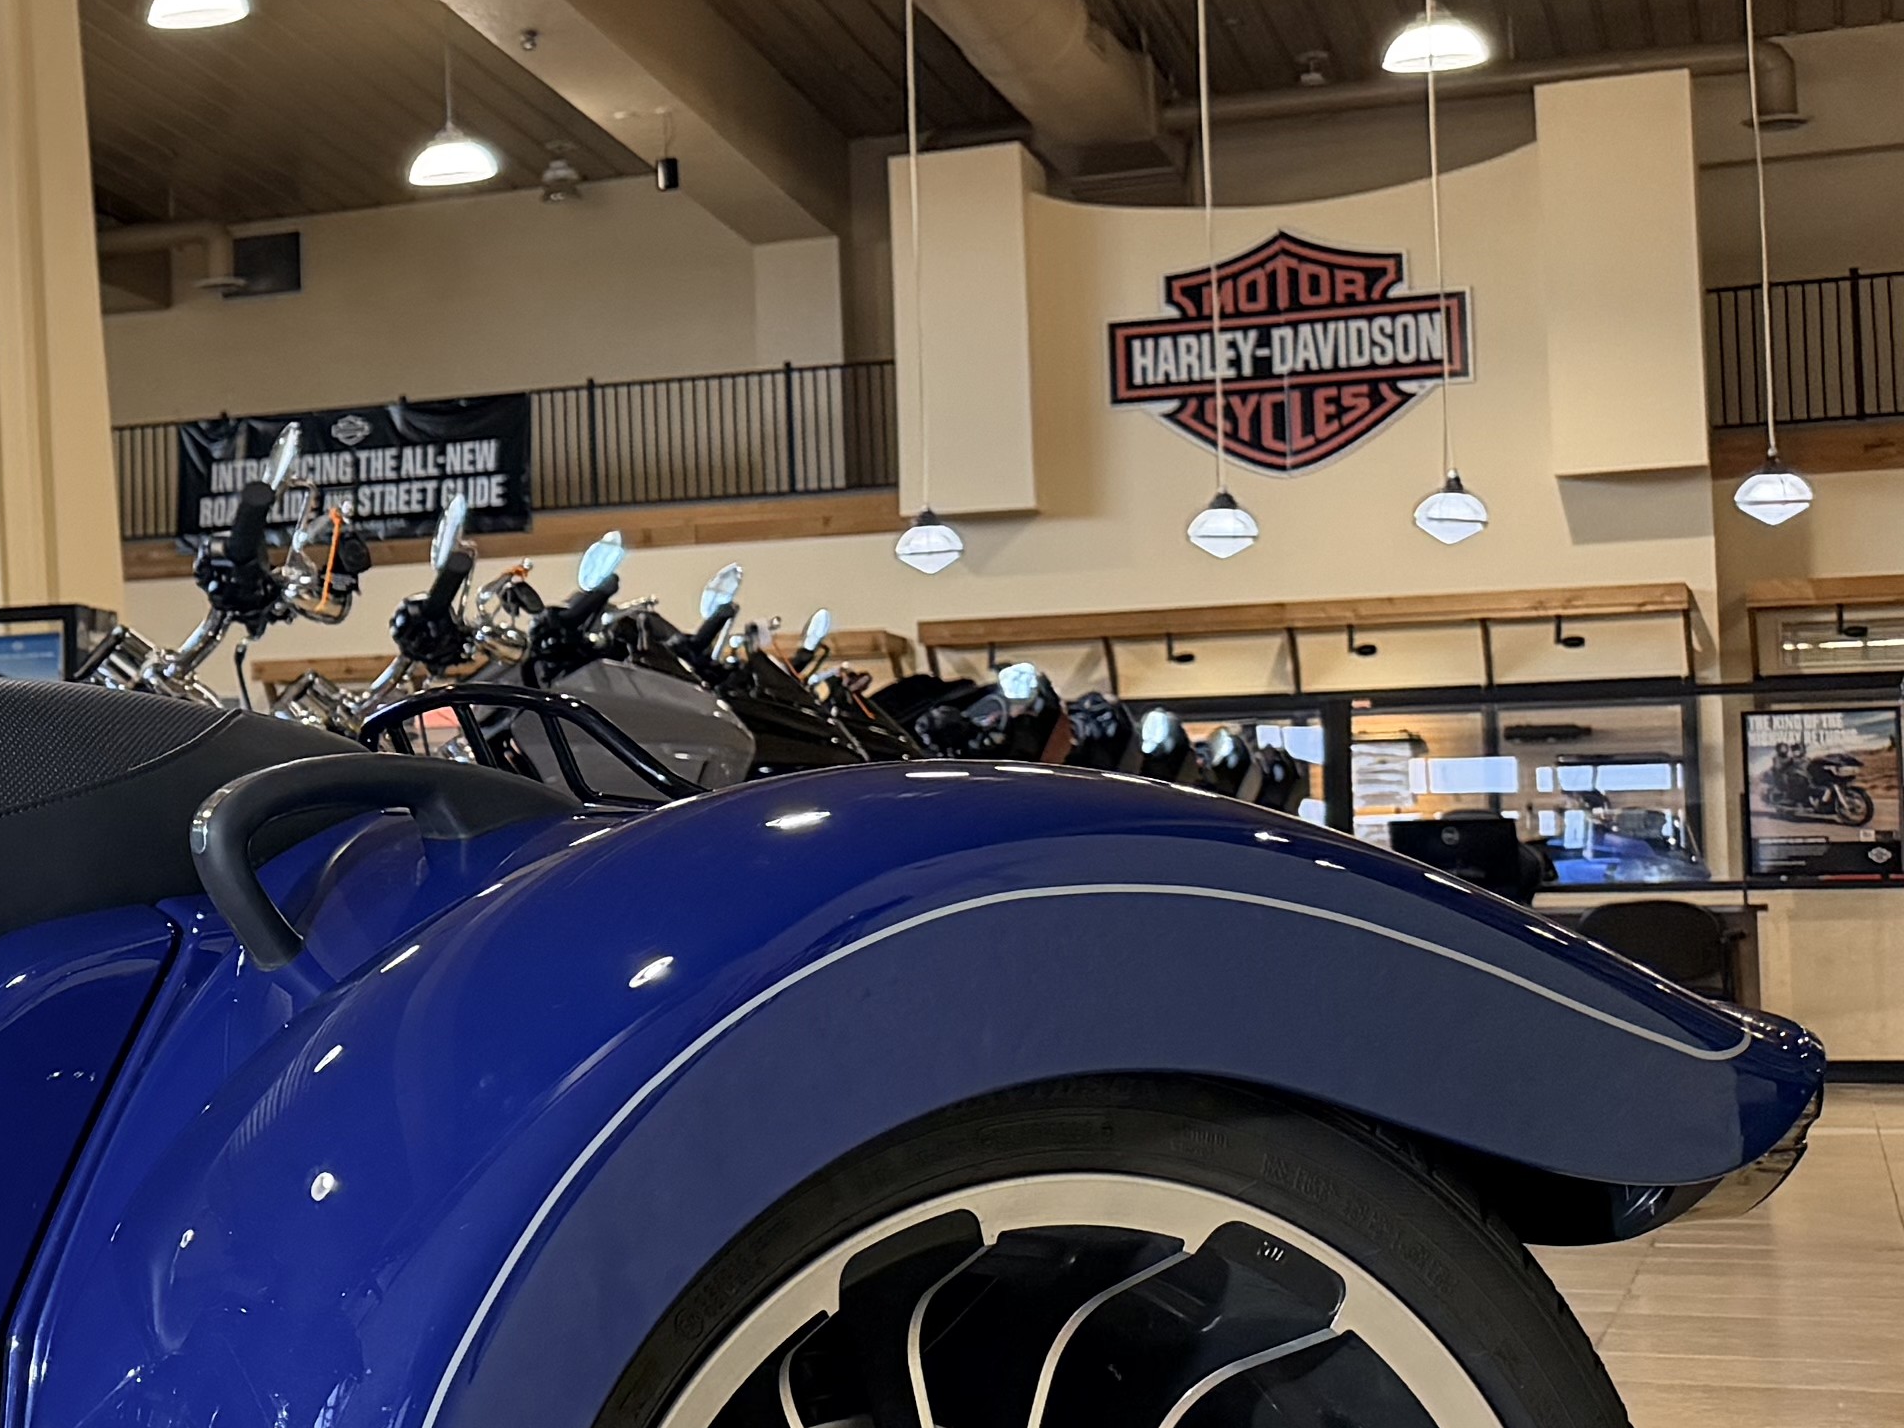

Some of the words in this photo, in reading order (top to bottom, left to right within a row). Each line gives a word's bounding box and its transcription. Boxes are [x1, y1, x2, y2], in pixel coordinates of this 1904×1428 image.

[1202, 255, 1368, 315] MOTOR
[1131, 312, 1445, 386] HARLEY-DAVIDSON
[1204, 384, 1371, 452] CYCLES
[357, 446, 398, 481] THE
[400, 438, 497, 479] ALL-NEW
[199, 494, 243, 528] ROA
[357, 479, 438, 517] STREET
